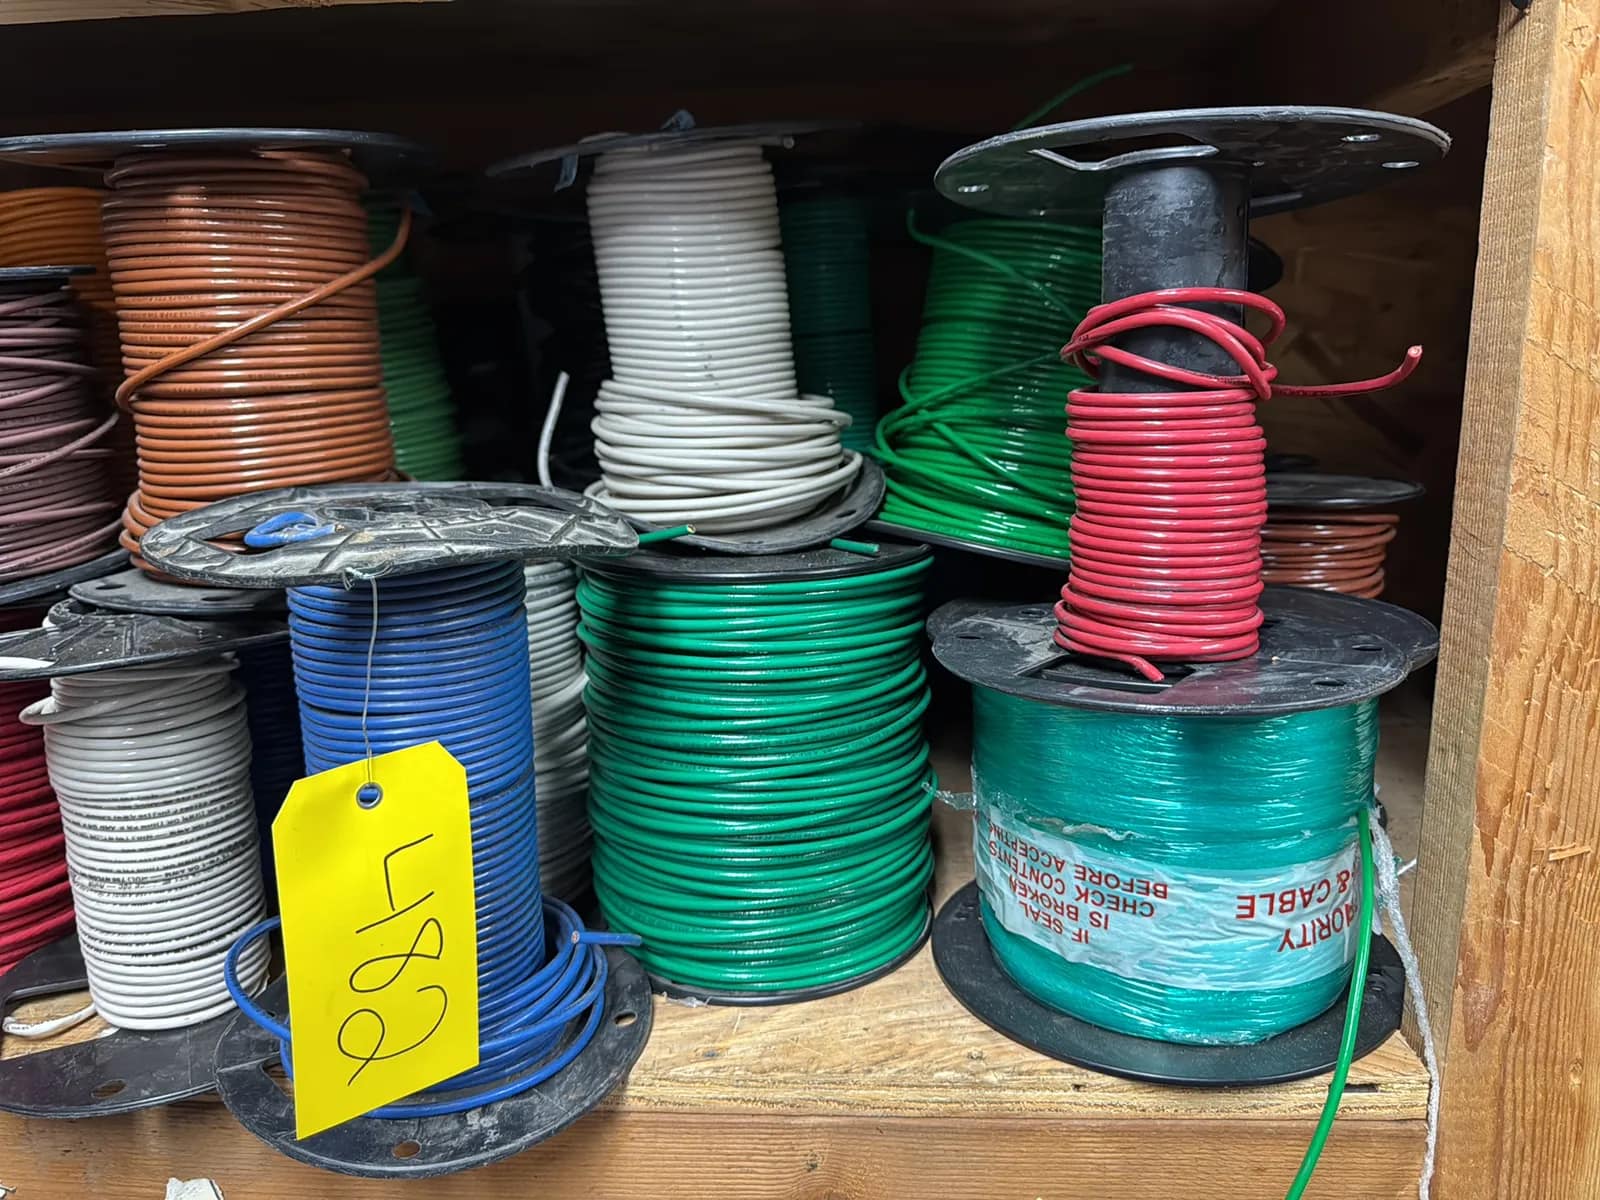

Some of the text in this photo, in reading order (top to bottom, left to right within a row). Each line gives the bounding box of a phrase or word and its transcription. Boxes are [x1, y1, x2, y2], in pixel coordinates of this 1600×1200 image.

[988, 840, 1155, 918] CHECK CONTENTS
[1073, 863, 1169, 900] BEFORE
[1235, 878, 1331, 919] CABLE
[1336, 869, 1351, 894] &
[1008, 874, 1110, 930] IS BROKEN
[1018, 901, 1089, 944] IF SEAL
[337, 834, 447, 1086] 482
